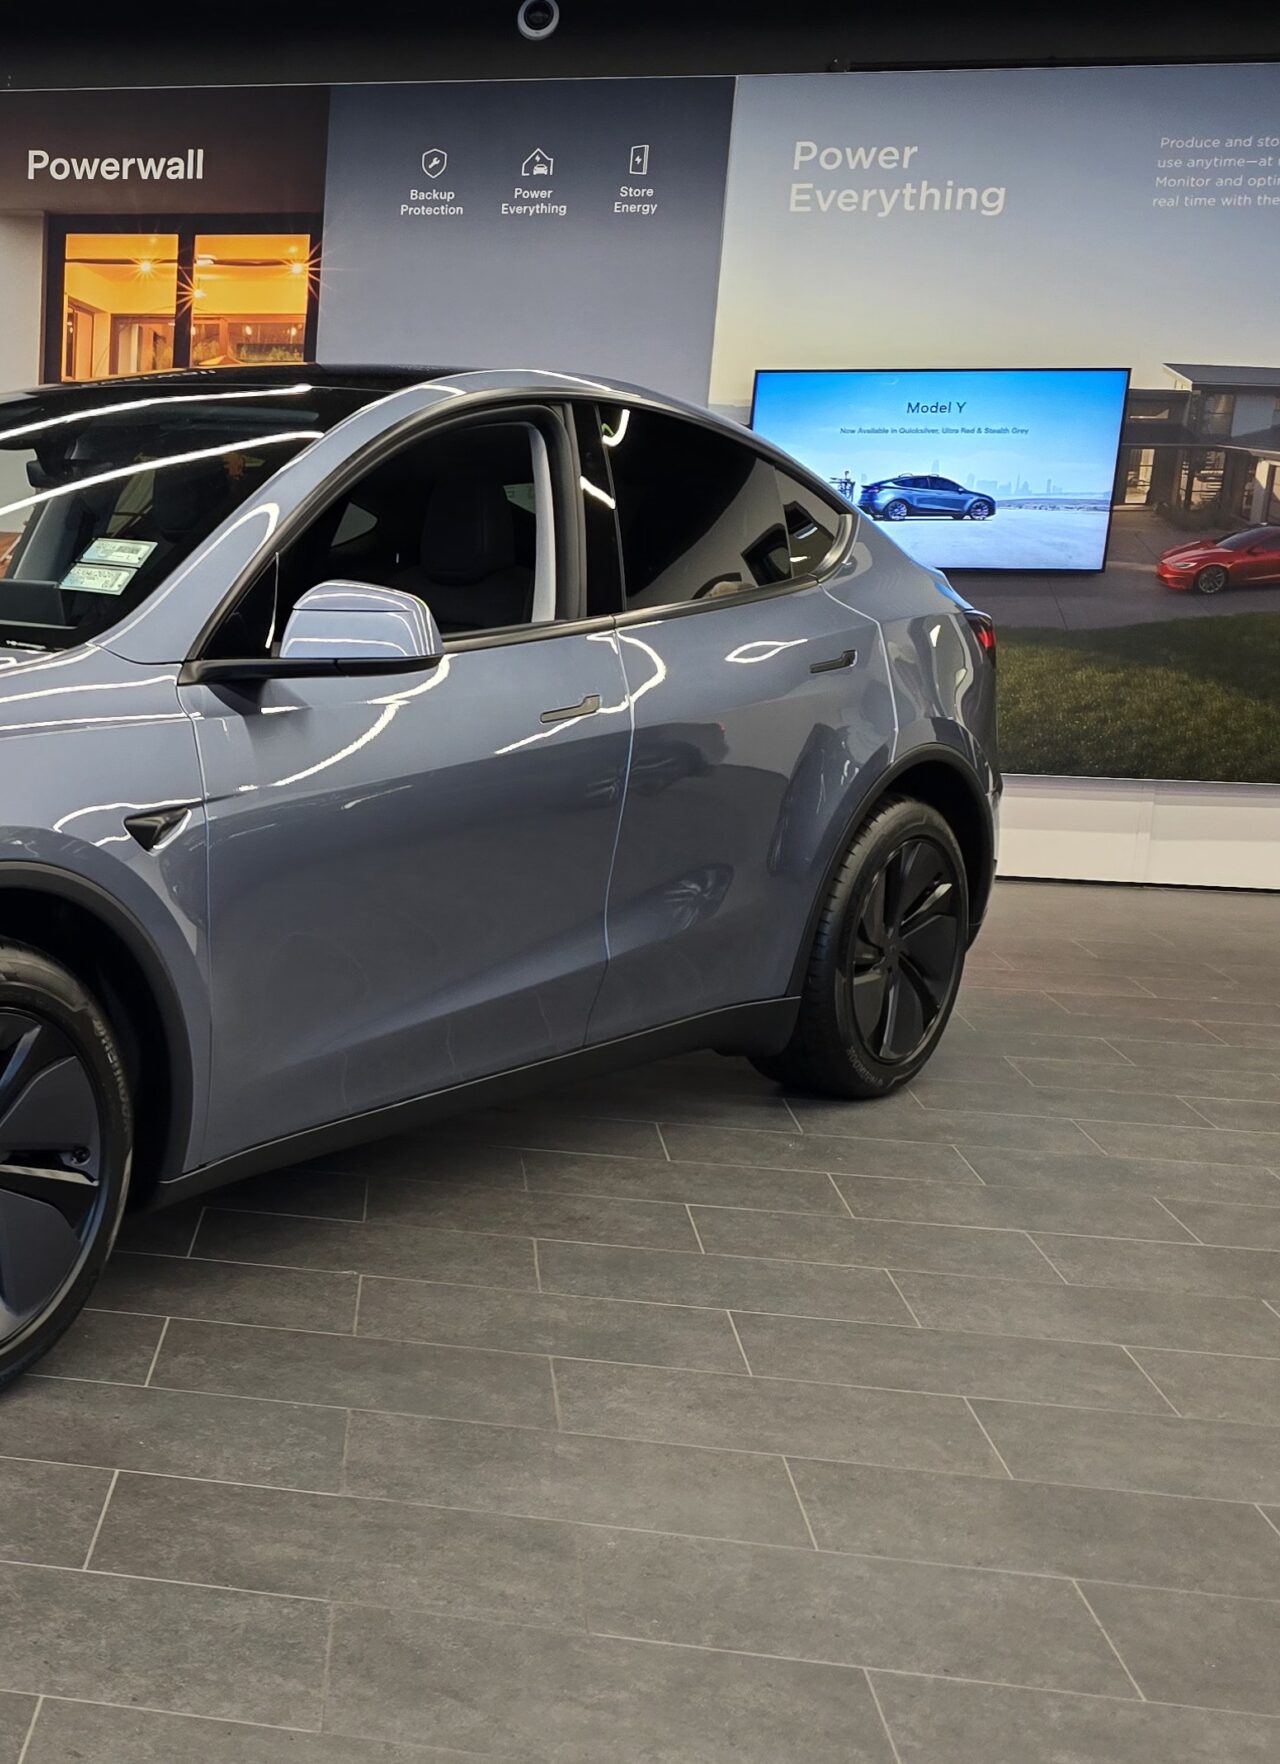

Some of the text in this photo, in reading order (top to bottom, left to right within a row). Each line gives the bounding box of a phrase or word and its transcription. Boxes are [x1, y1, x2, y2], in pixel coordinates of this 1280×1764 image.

[1160, 137, 1220, 148] Produce
[1225, 136, 1253, 147] and
[793, 141, 918, 171] Power
[27, 149, 204, 181] Powerwall
[1157, 159, 1182, 168] use
[1155, 176, 1211, 187] Monitor
[1216, 176, 1243, 187] and
[410, 189, 455, 202] Backup
[514, 187, 553, 199] Power
[619, 186, 654, 197] Store
[789, 180, 1006, 217] Everything
[1152, 194, 1280, 207] real time with the
[400, 204, 464, 216] Protection
[501, 202, 567, 216] Everything
[614, 202, 657, 215] Energy
[907, 401, 967, 414] Model Y
[1011, 427, 1029, 435] Grey
